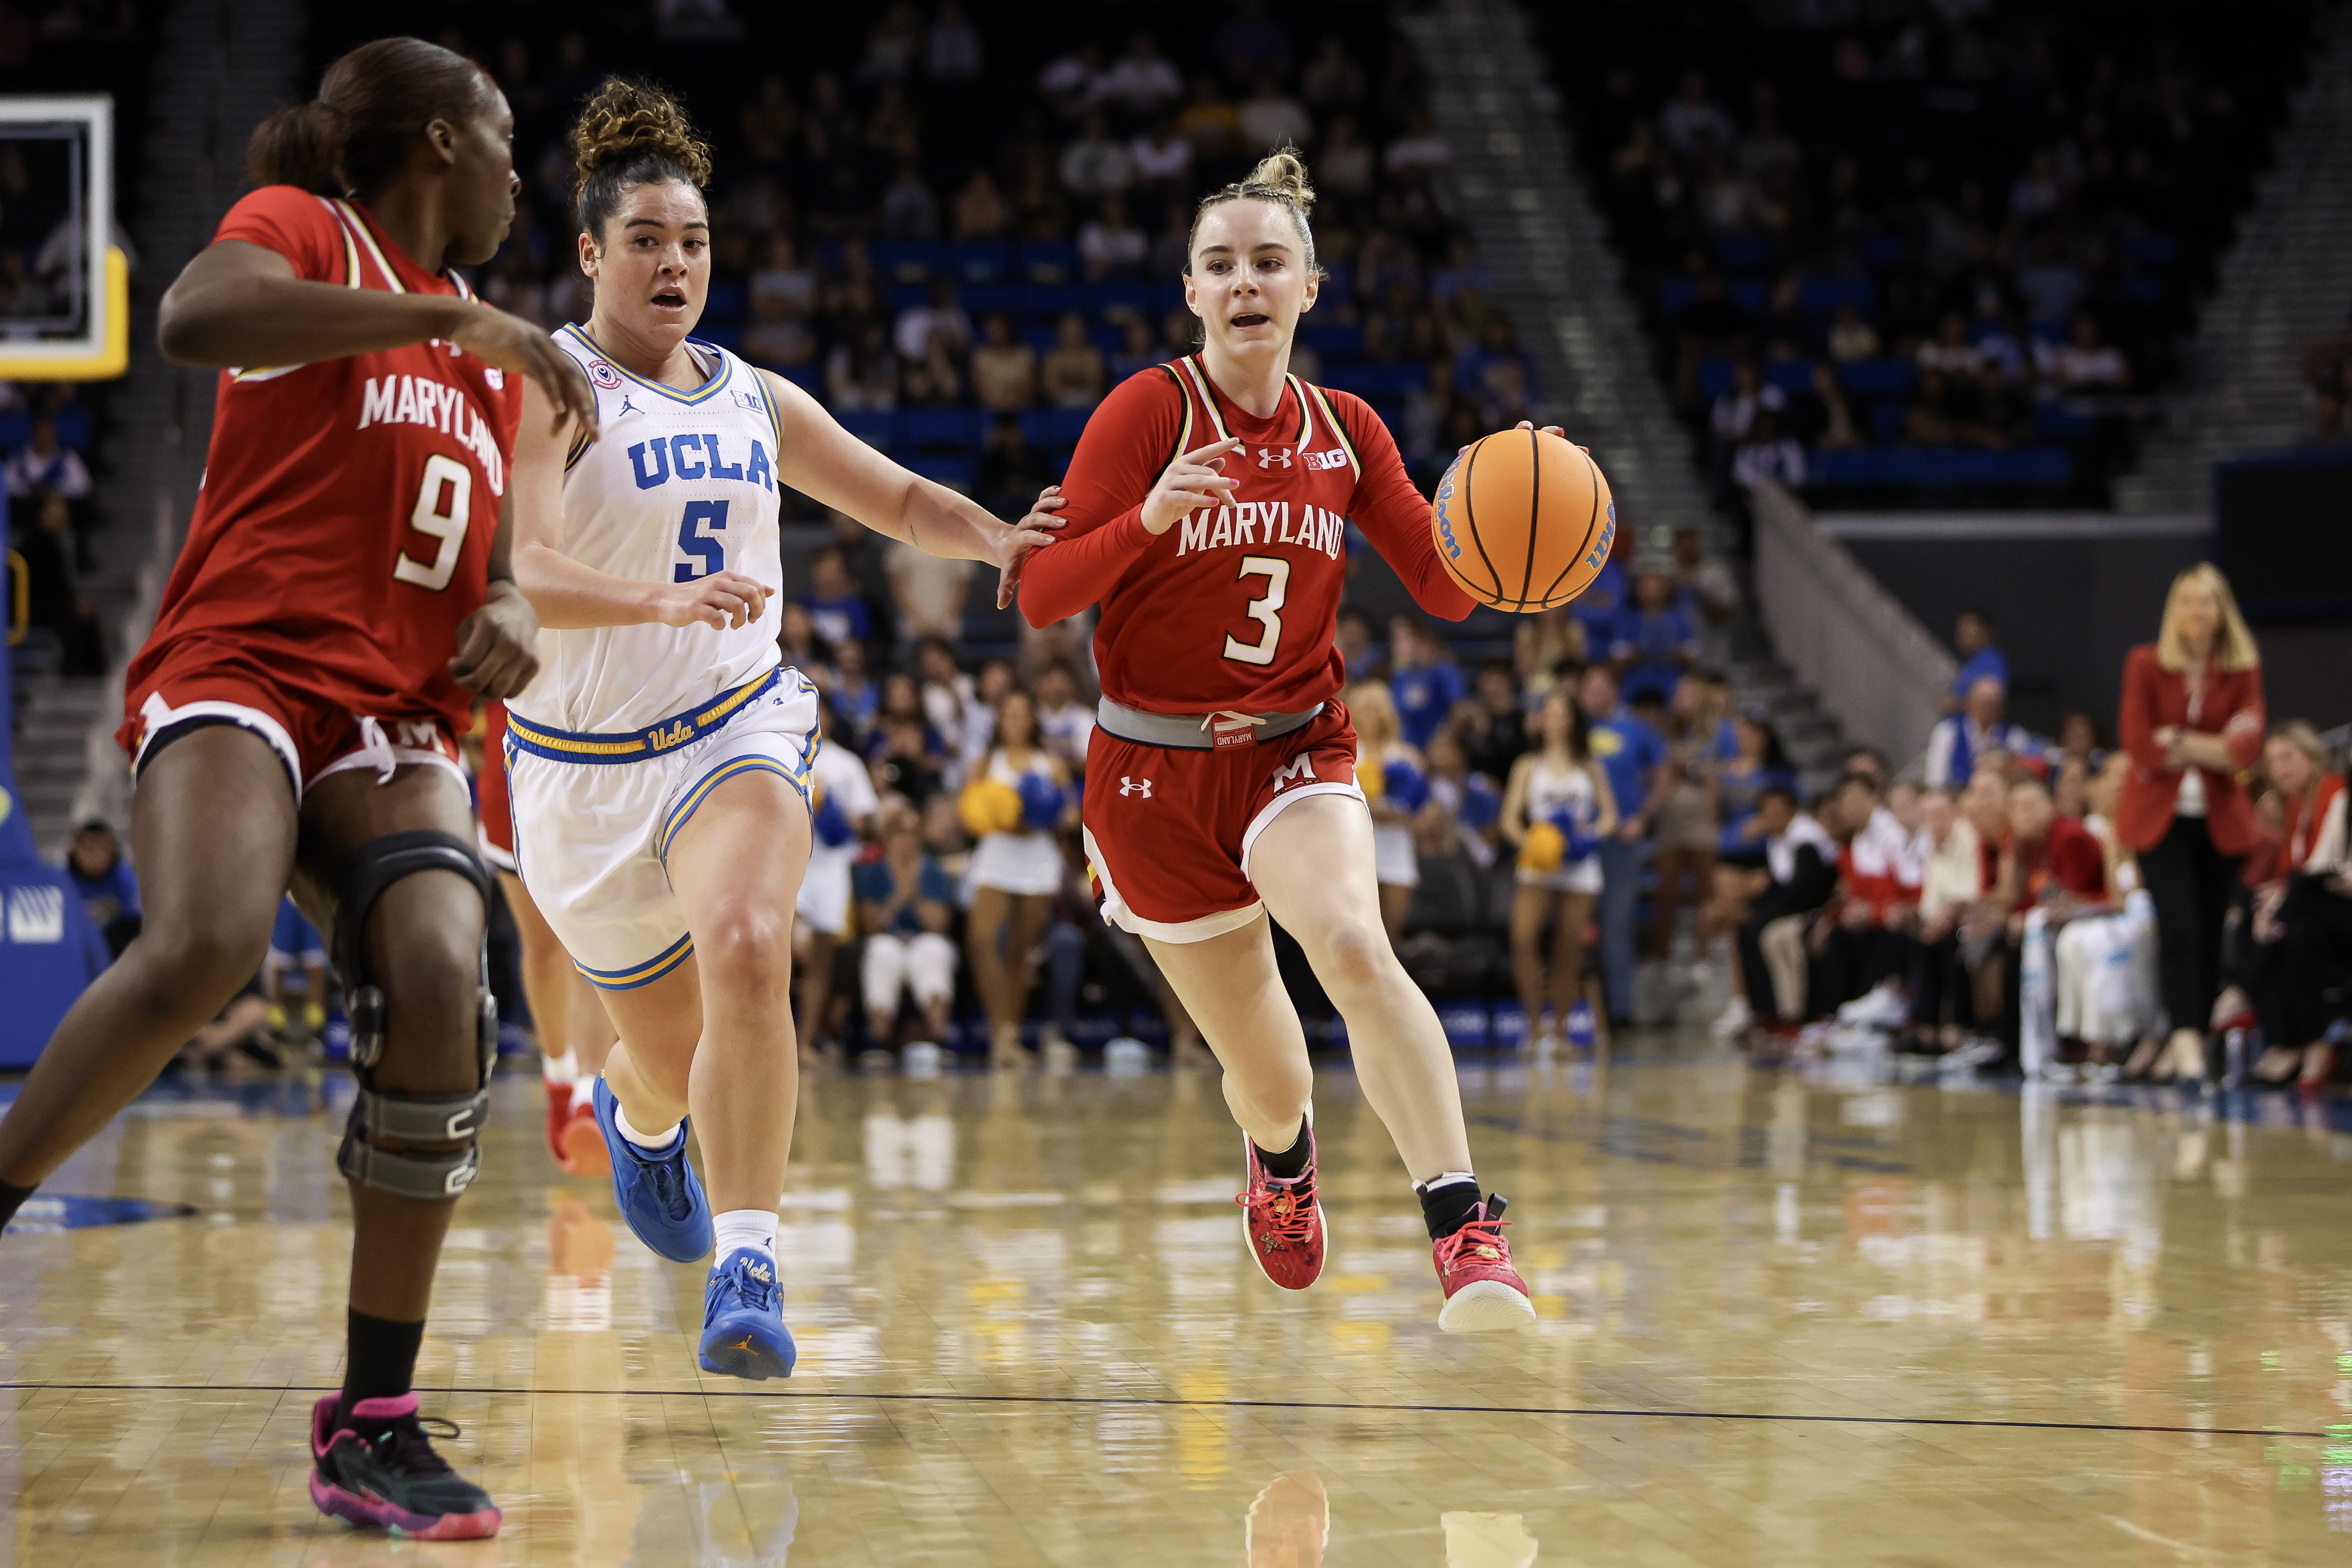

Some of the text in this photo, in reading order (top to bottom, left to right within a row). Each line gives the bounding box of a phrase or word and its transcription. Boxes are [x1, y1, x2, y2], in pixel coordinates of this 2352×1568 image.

[357, 374, 504, 497] MARYLAND
[628, 434, 772, 493] UCLA
[394, 453, 472, 591] 9
[674, 500, 729, 583] 5
[1176, 502, 1343, 560] MARYLAND
[1223, 554, 1291, 666] 3
[648, 720, 695, 751] Ucla
[1217, 732, 1252, 746] MARYLAND
[1272, 752, 1317, 793] M
